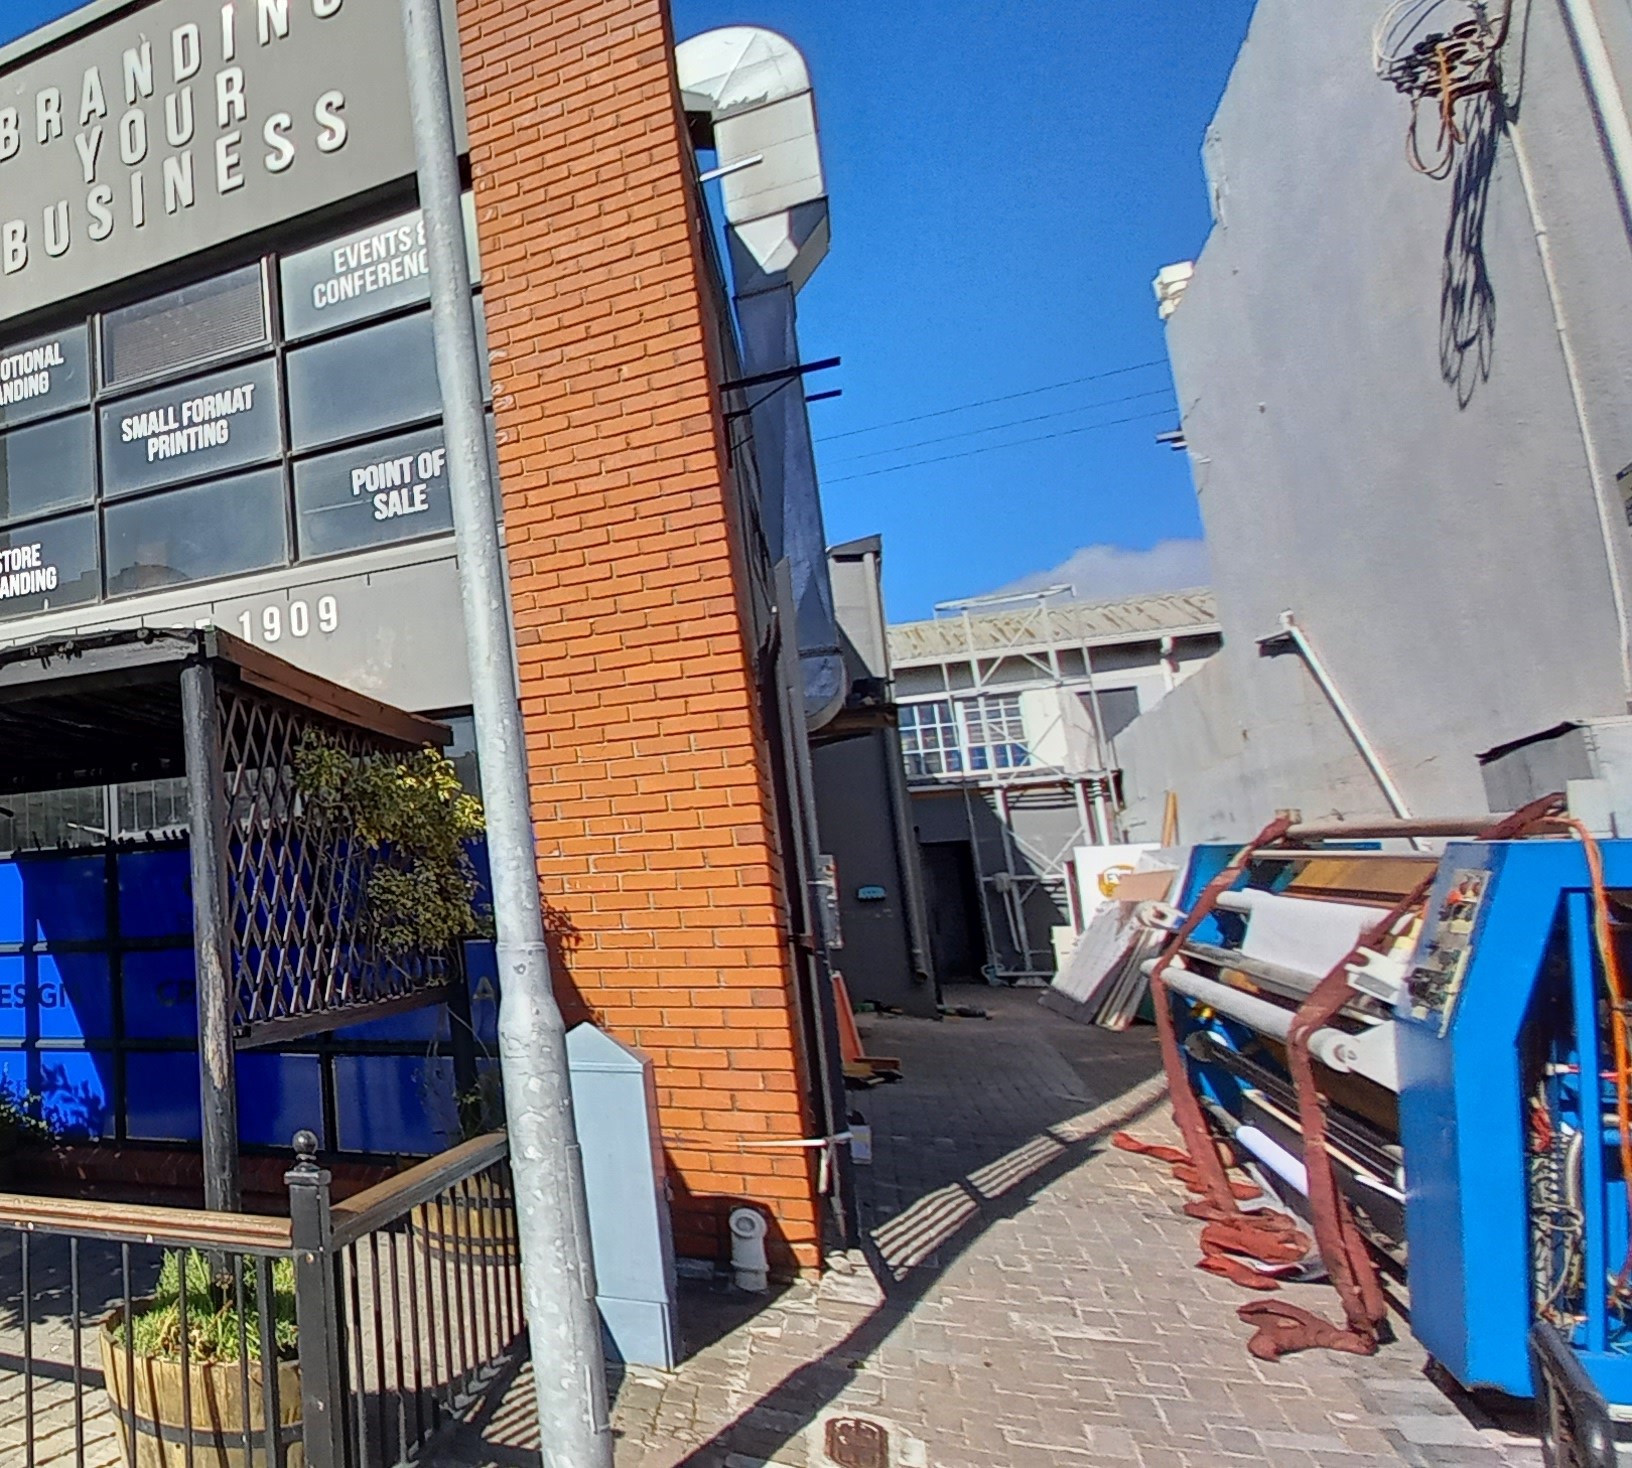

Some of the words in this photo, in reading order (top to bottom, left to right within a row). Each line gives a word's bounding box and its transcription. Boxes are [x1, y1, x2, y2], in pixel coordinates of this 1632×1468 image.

[74, 65, 247, 184] YOUR
[3, 90, 349, 276] BUSINESS
[333, 225, 412, 274] EVENTS
[313, 248, 429, 309] CONFERENC
[121, 405, 180, 443] SMALL
[181, 383, 255, 424] FORMAT
[147, 419, 229, 462] PRINTING
[351, 455, 414, 496] POINT
[417, 448, 446, 480] OF
[373, 483, 429, 521] SALE
[237, 594, 339, 643] 1909
